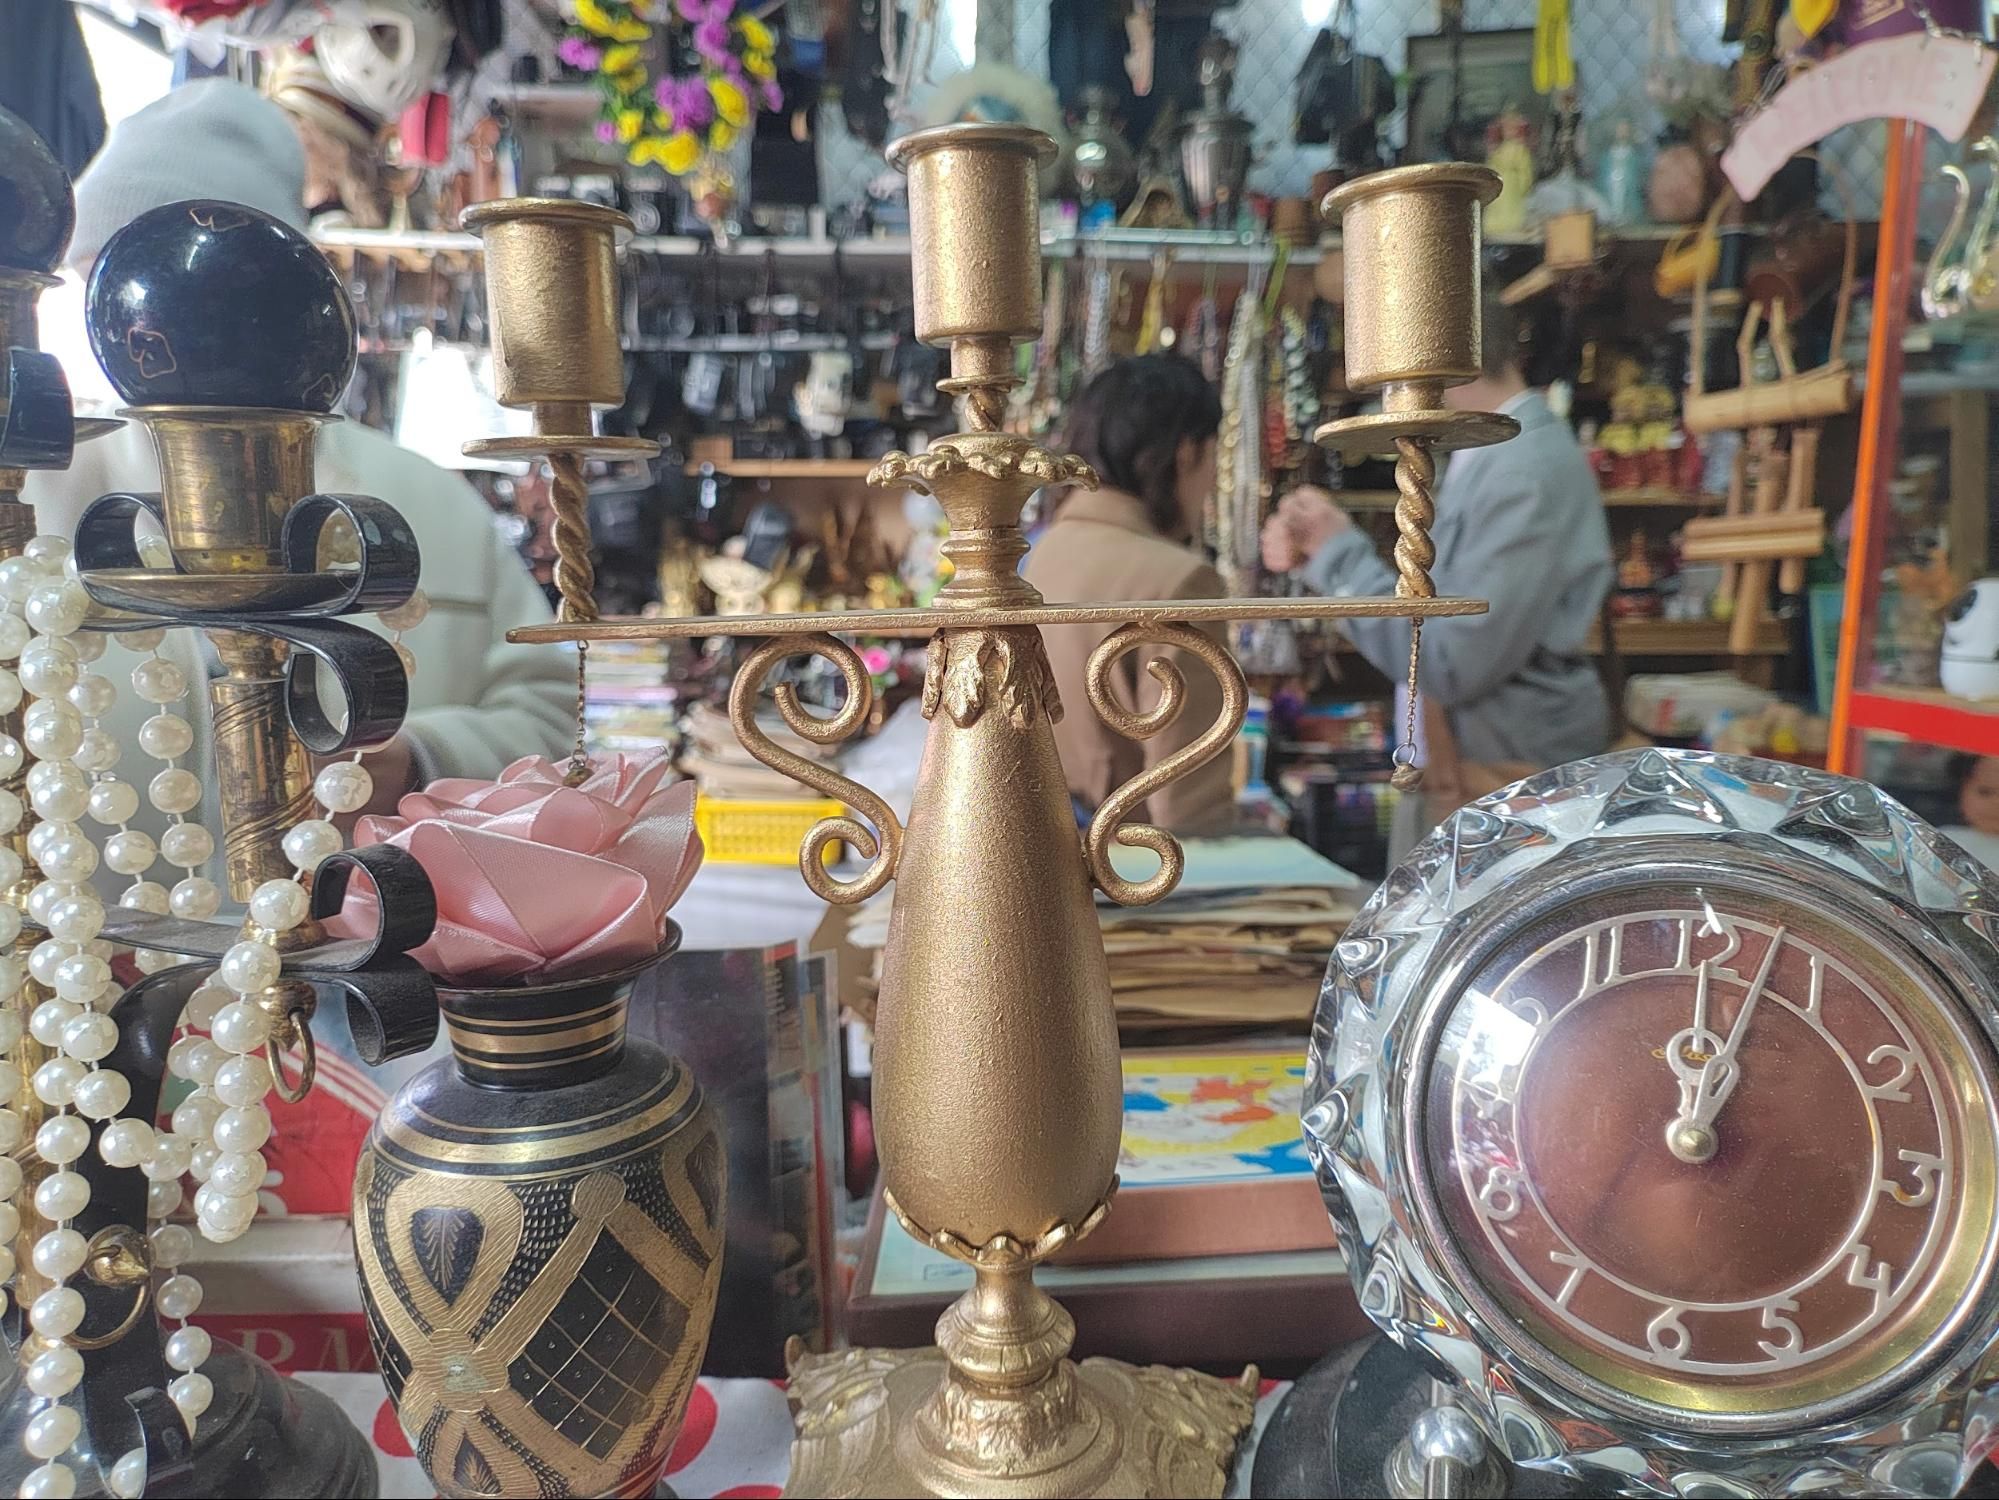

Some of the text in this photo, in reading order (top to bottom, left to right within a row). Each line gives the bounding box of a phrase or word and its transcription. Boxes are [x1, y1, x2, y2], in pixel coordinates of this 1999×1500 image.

[1577, 924, 1624, 998] 11
[1675, 916, 1741, 979] 12
[1804, 955, 1823, 1025] 1
[1866, 1044, 1916, 1102] 2
[1479, 1167, 1521, 1221] 8
[1880, 1149, 1943, 1206] 3
[1550, 1249, 1591, 1307] 7
[1845, 1243, 1891, 1310] 4
[1647, 1307, 1690, 1359] 6
[1757, 1300, 1804, 1358] 5
